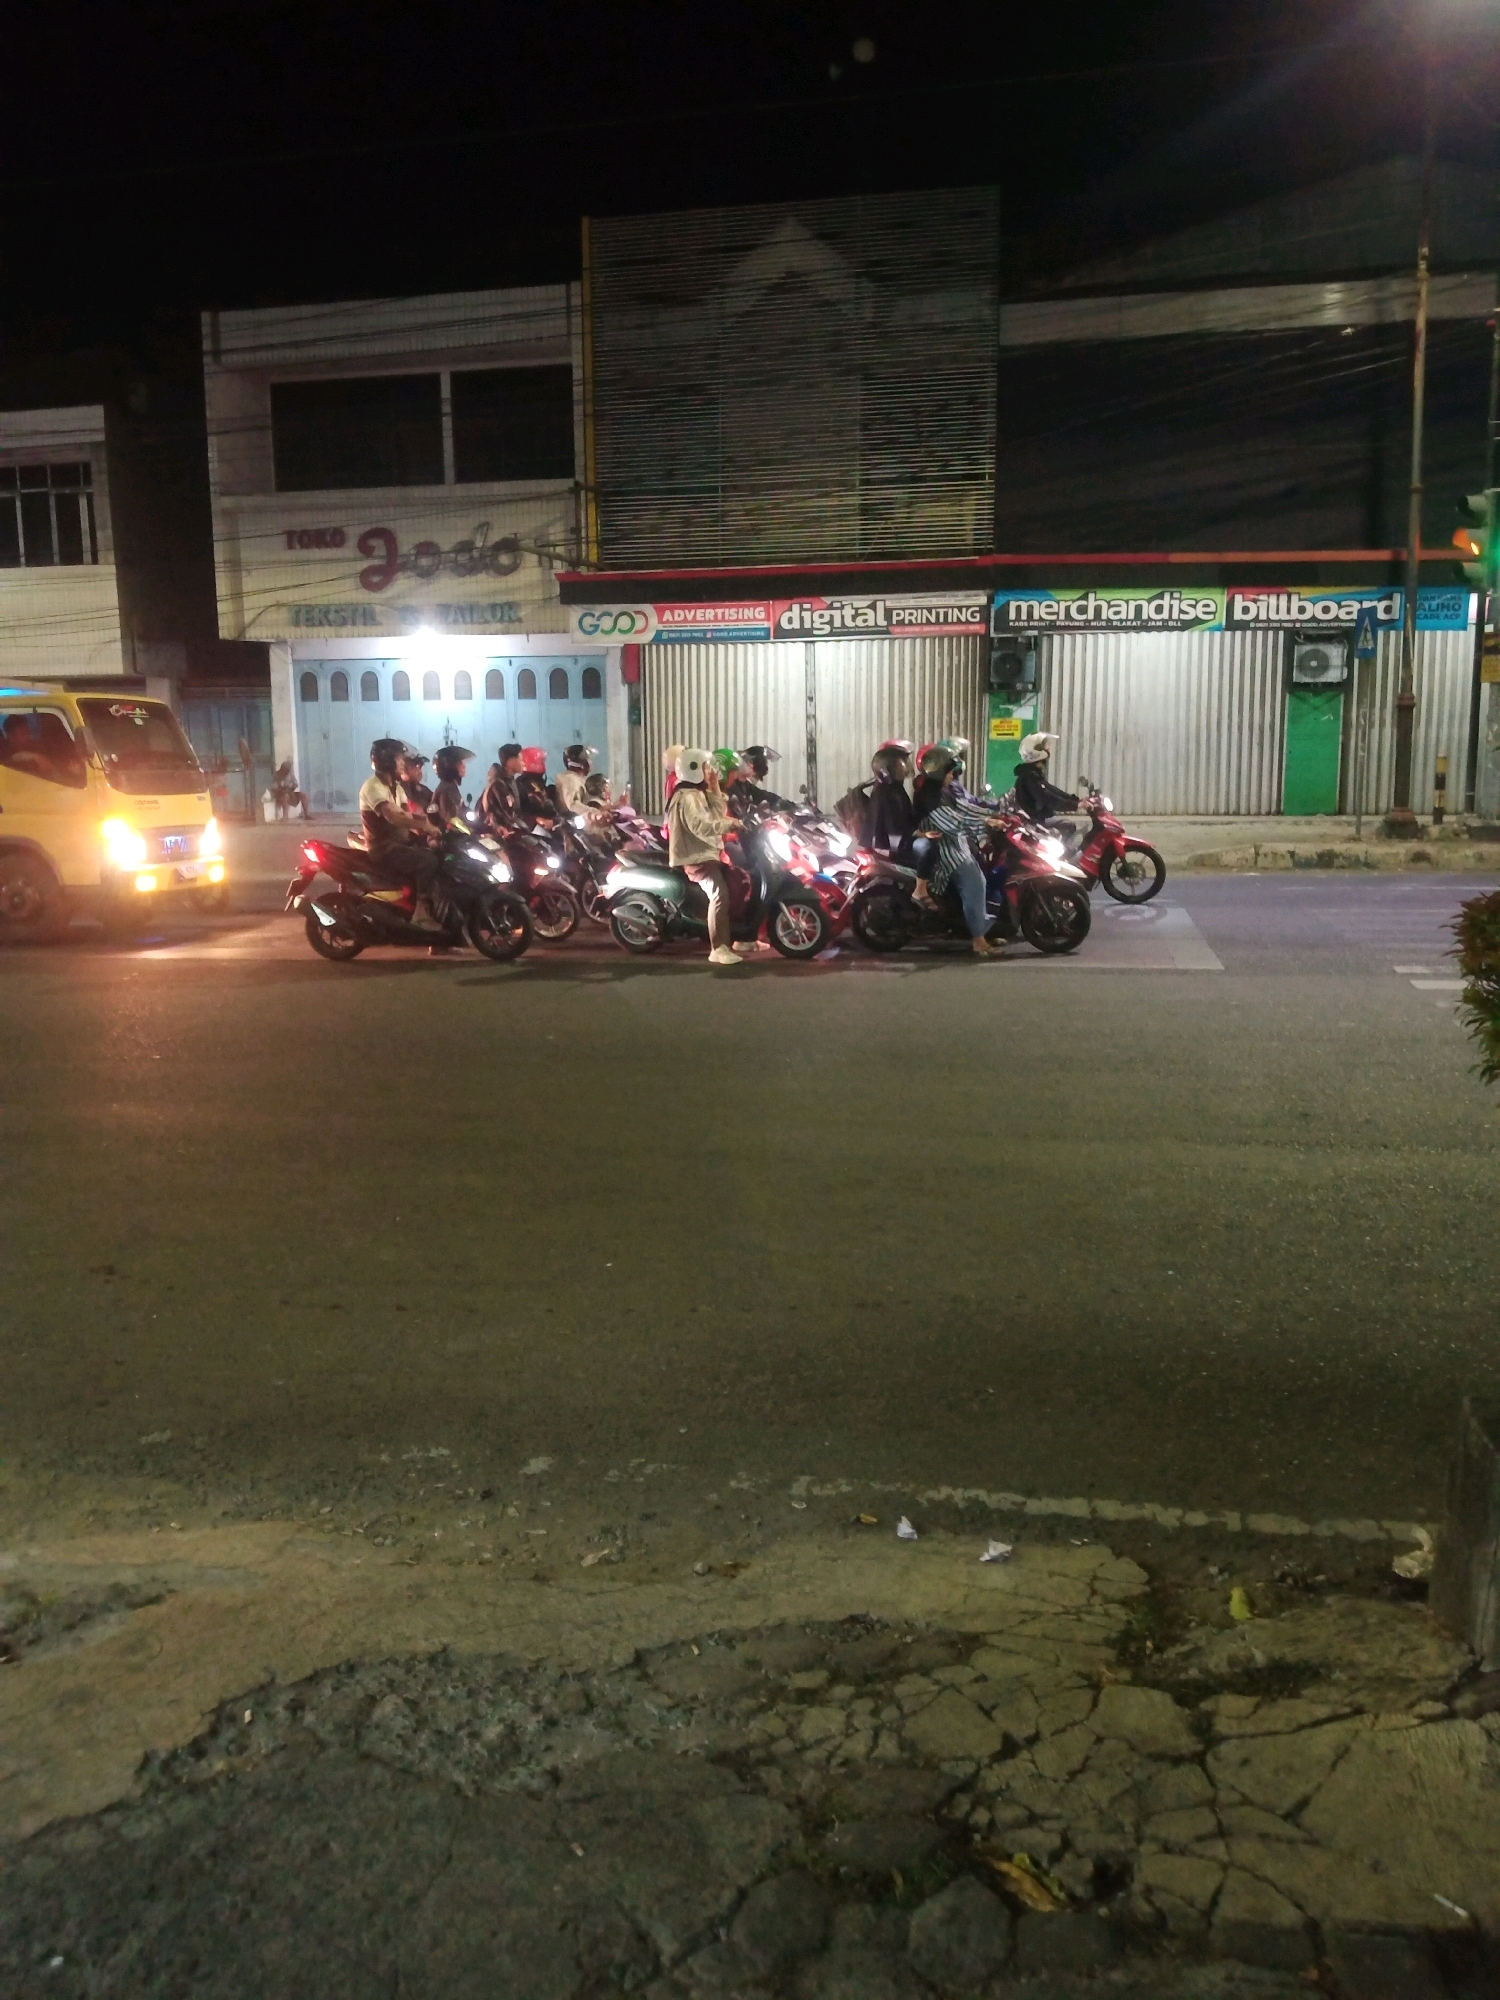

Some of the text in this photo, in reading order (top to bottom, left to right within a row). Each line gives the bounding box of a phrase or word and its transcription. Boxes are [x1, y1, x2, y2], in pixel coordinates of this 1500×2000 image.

[283, 527, 346, 550] TOKO
[290, 603, 381, 627] TEKSTIL
[435, 601, 523, 625] TAILOR
[662, 607, 766, 622] ADVERTISING
[779, 600, 888, 635] digital
[892, 606, 980, 625] PRINTING
[1008, 591, 1217, 620] merchandise
[1416, 602, 1462, 612] ALIHO
[578, 610, 649, 635] GOOD
